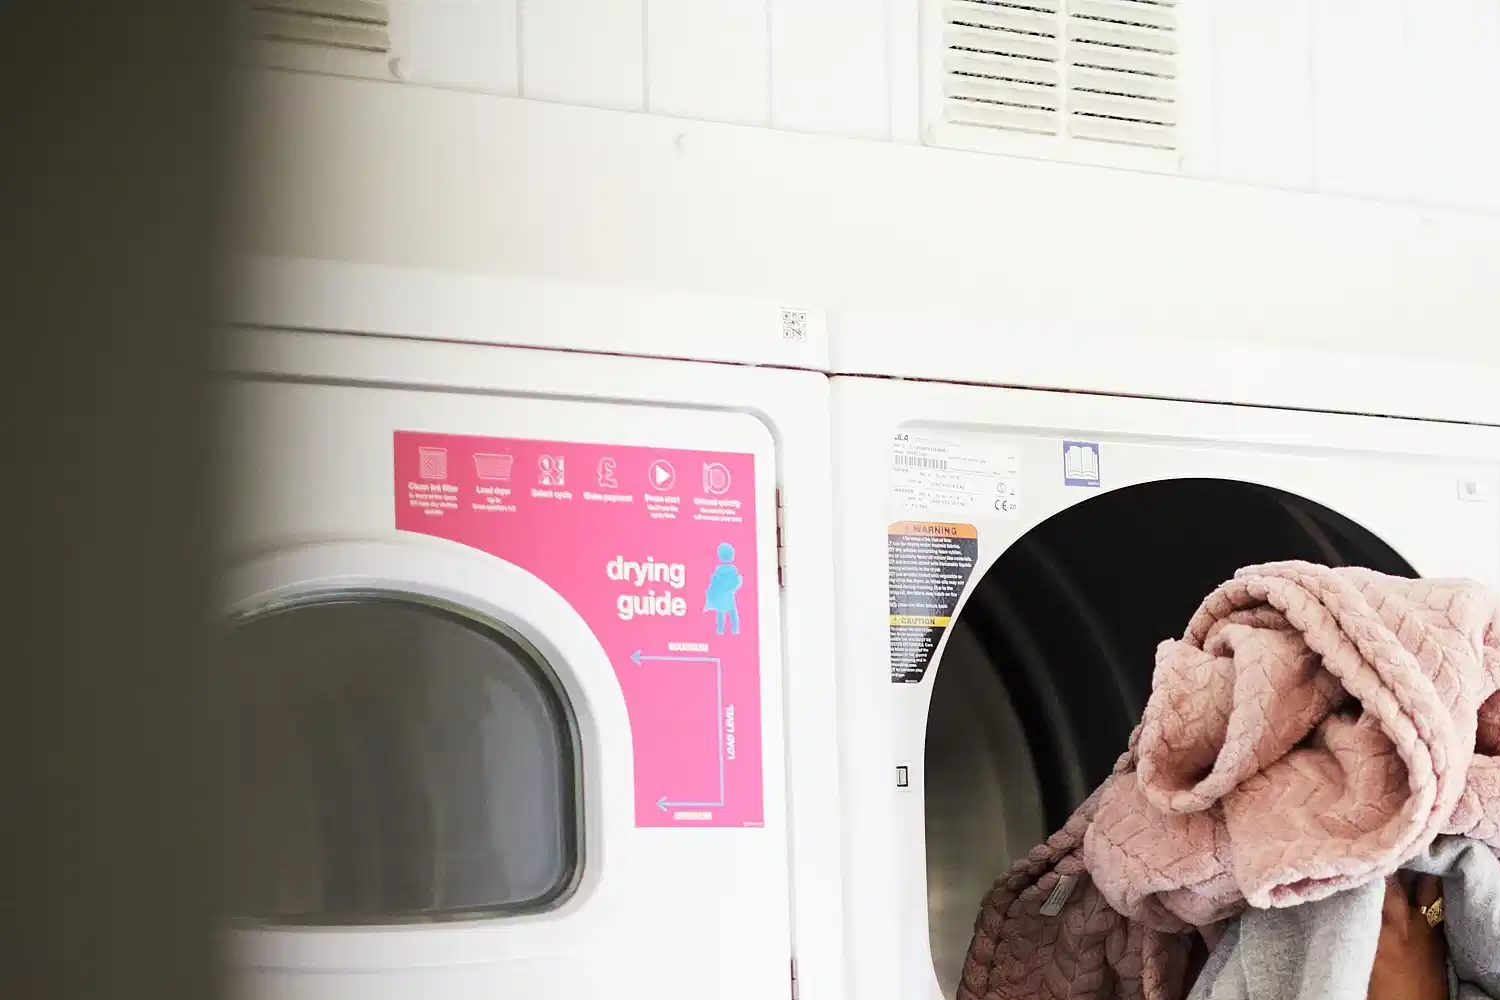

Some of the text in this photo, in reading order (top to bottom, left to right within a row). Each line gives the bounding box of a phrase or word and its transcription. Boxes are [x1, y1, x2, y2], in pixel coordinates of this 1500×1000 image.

[913, 526, 957, 536] WARNING
[606, 555, 686, 588] drying
[616, 590, 687, 621] guide
[901, 617, 936, 625] CAUTION
